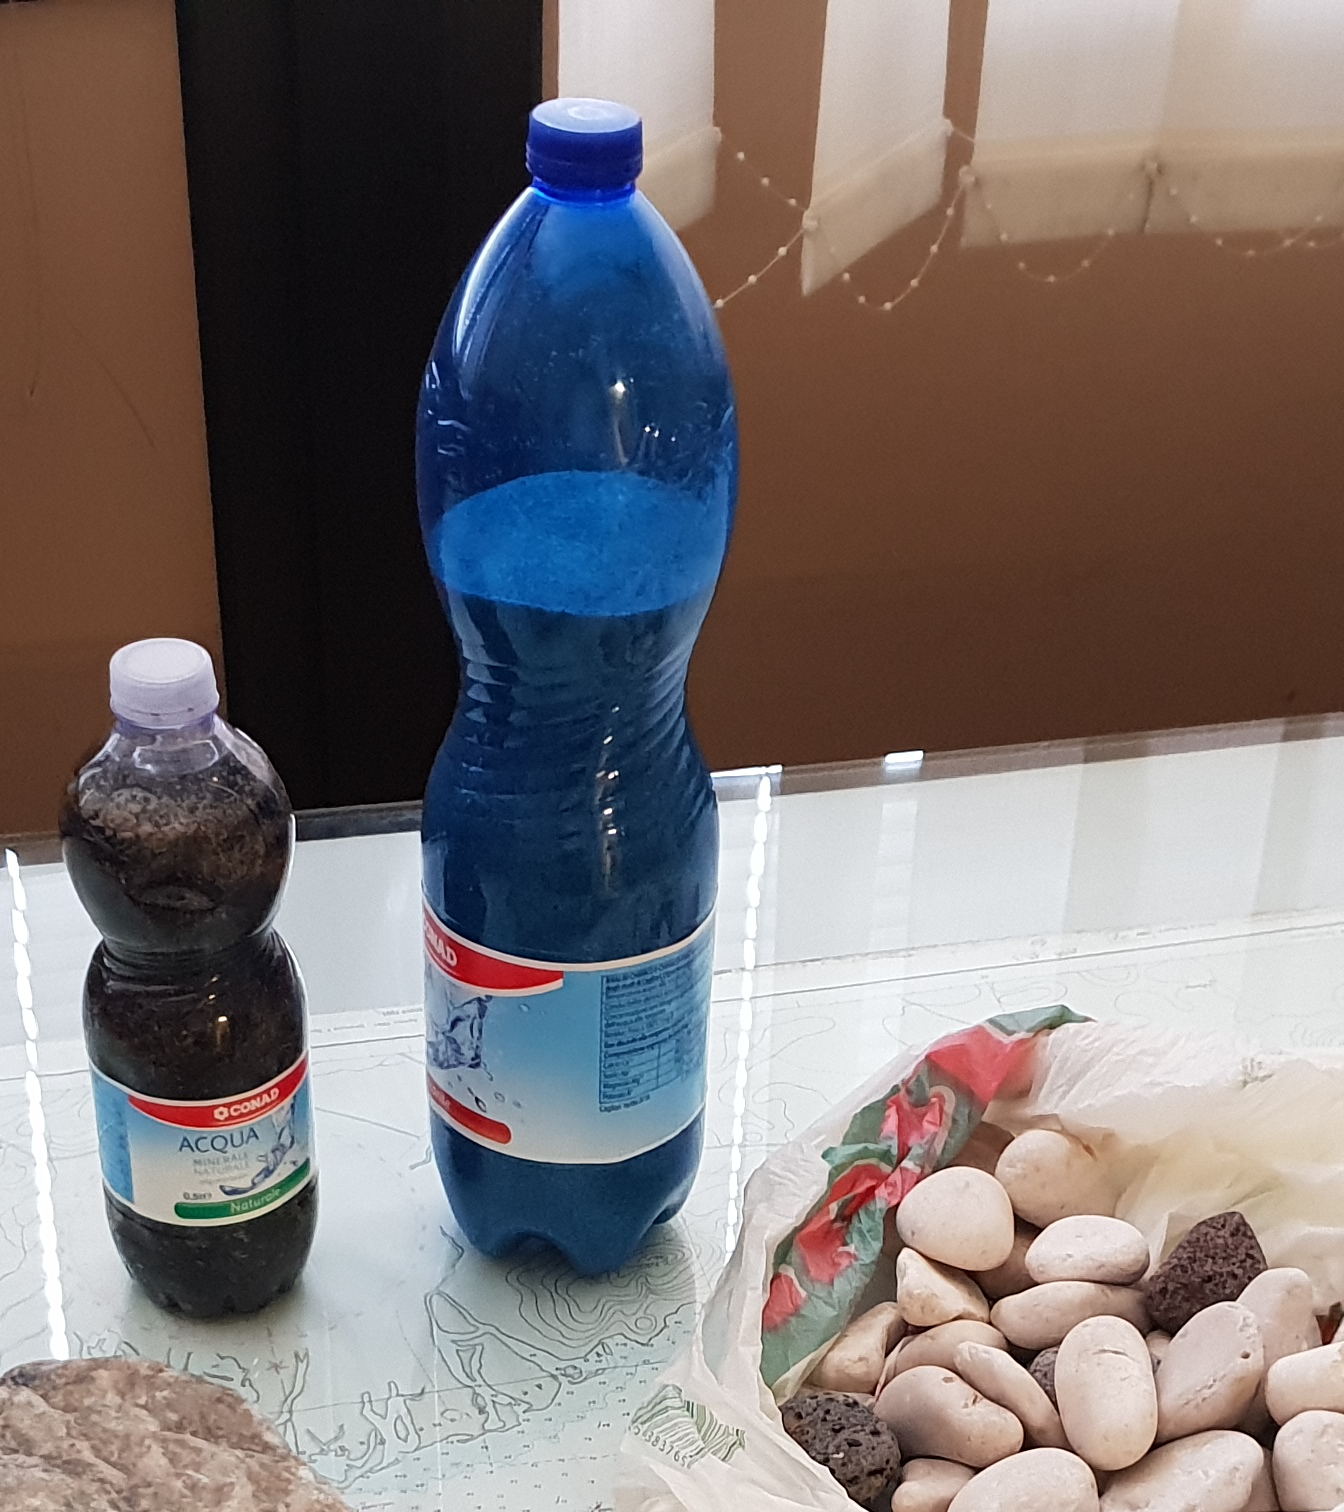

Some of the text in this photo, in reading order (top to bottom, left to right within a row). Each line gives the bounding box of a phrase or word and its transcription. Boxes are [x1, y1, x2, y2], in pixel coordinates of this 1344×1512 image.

[229, 1087, 280, 1118] CONAD
[178, 1126, 259, 1154] ACQUA
[230, 1187, 281, 1214] Naturale
